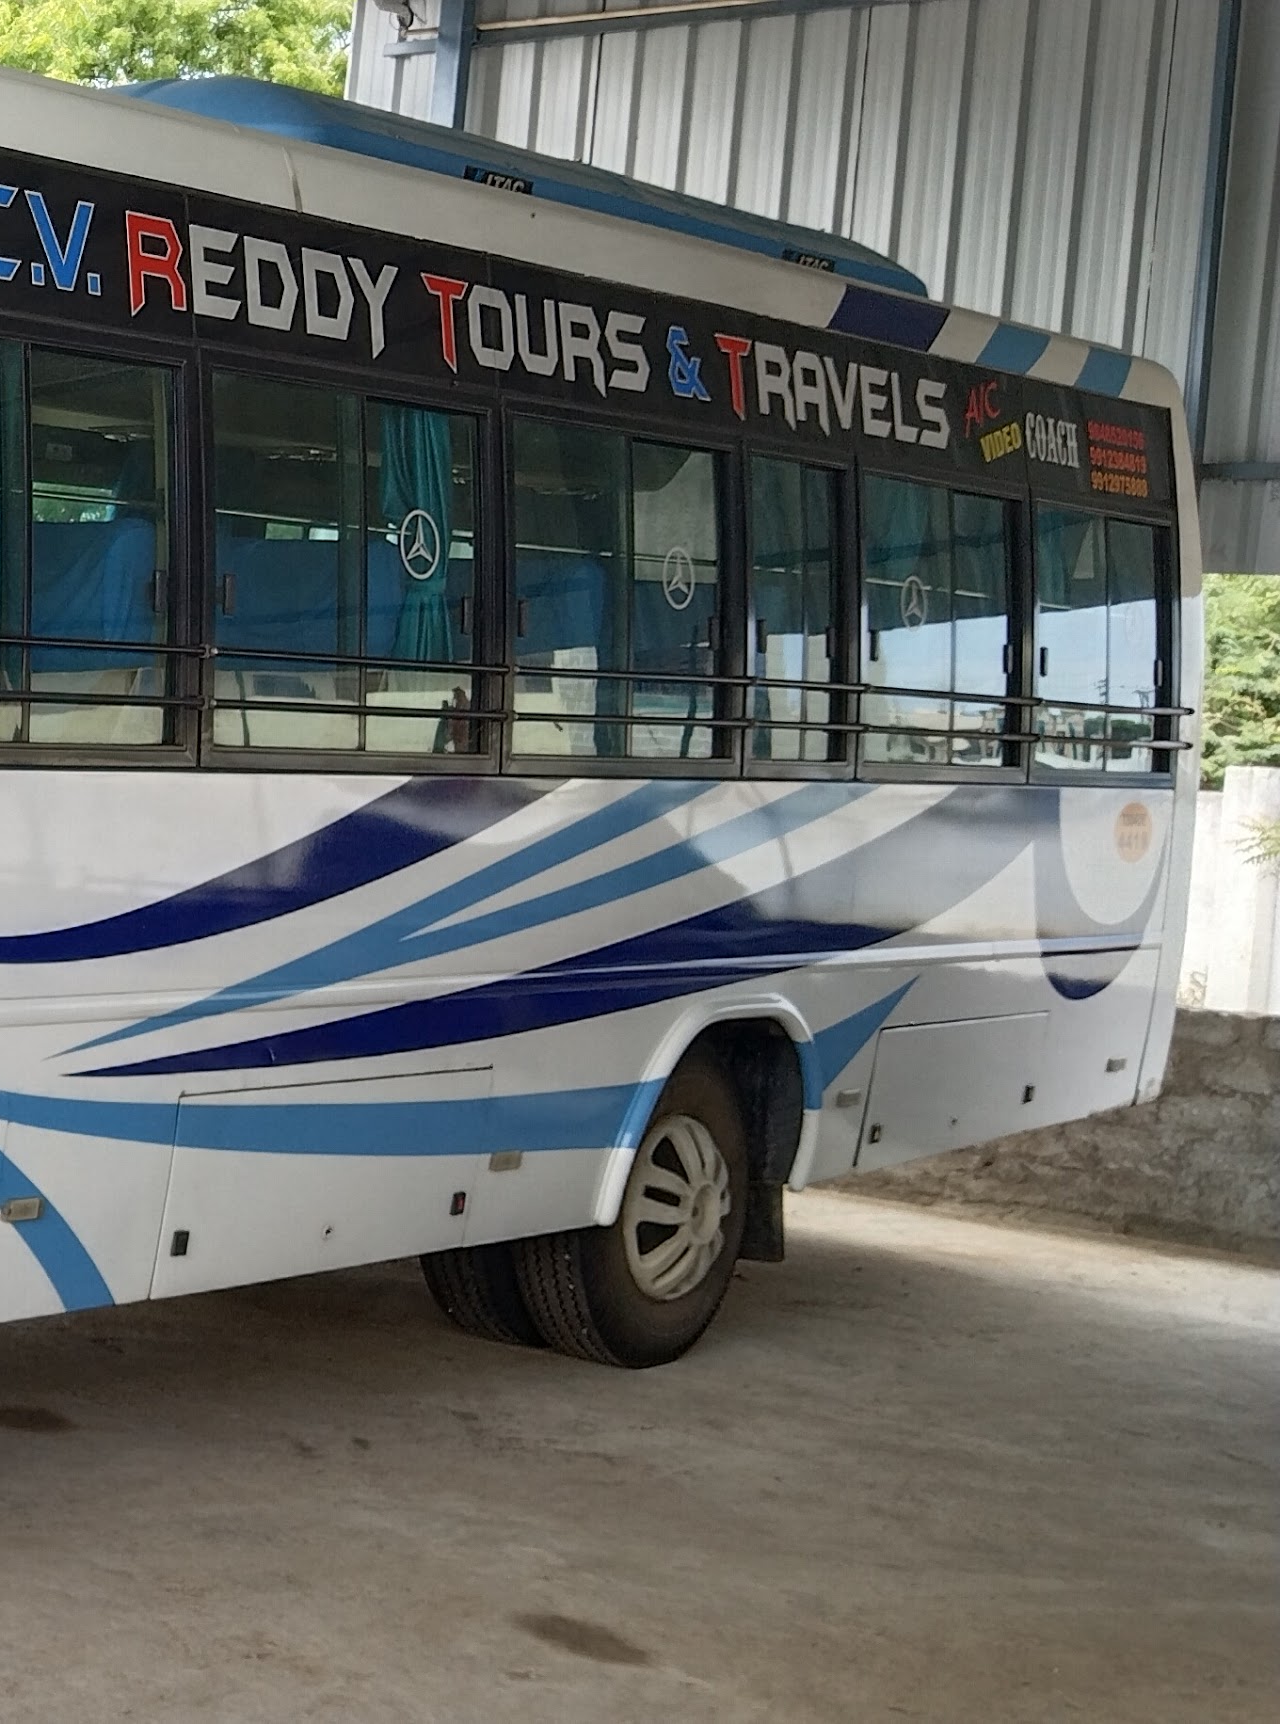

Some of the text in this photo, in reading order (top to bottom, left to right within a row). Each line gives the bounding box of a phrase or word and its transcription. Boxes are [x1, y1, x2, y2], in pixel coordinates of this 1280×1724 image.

[124, 209, 399, 360] REDDY
[421, 272, 651, 399] TOURS
[666, 325, 712, 402] &
[714, 332, 951, 450] TRAVELS
[979, 411, 1081, 469] VIDEO COACH
